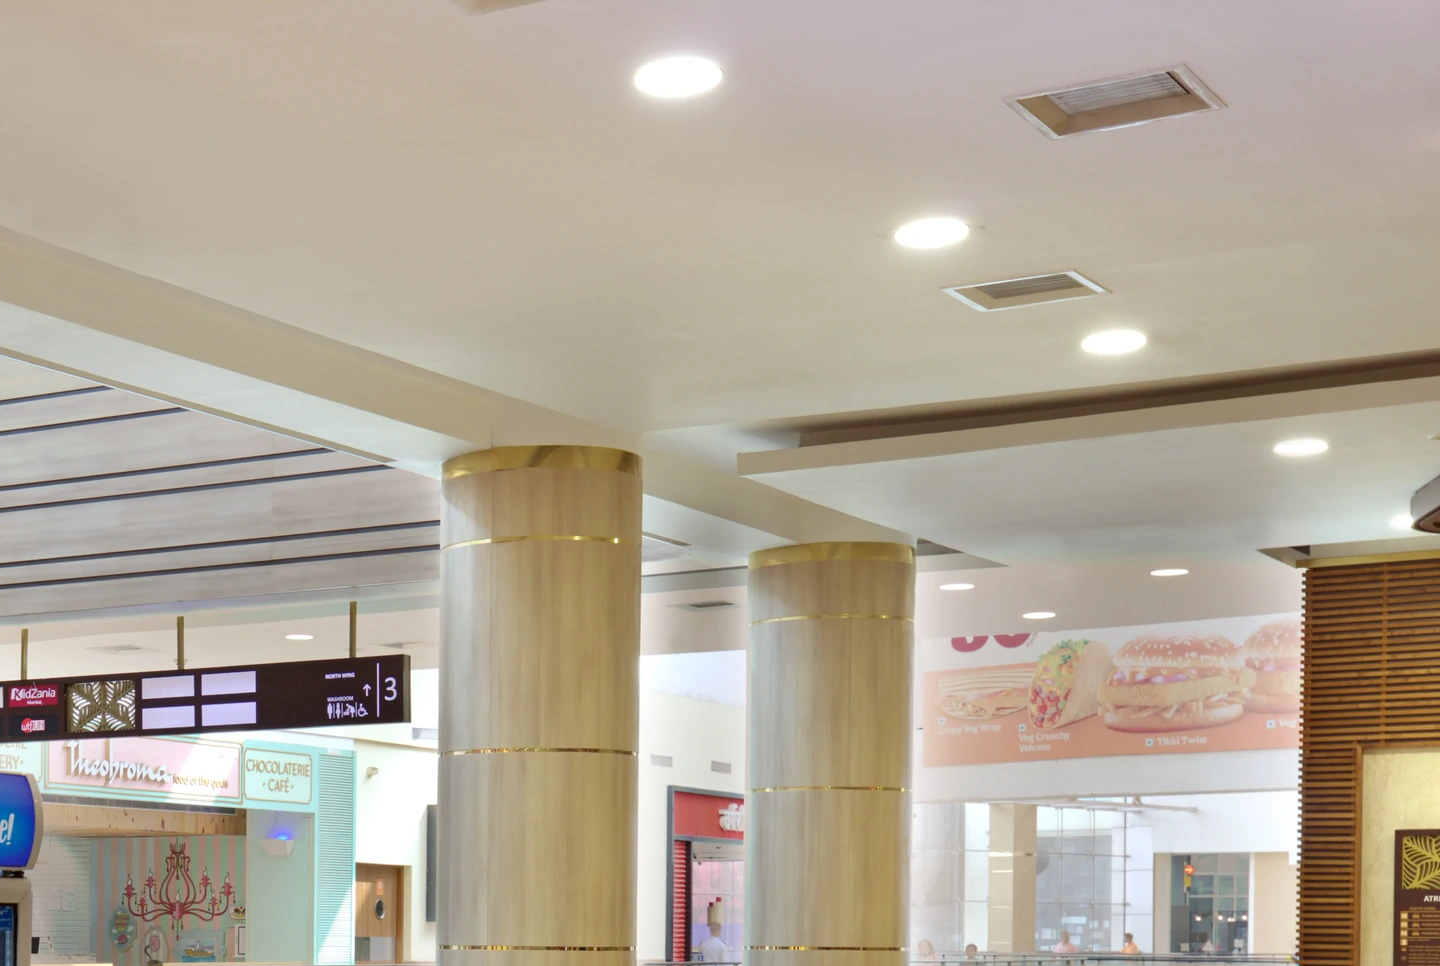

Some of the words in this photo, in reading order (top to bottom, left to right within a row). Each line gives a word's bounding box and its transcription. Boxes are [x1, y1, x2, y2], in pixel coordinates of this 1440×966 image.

[10, 687, 56, 701] KidZania
[384, 676, 398, 702] 3
[246, 758, 310, 777] CHOCOLATERIE
[268, 777, 290, 793] CAFÉ
